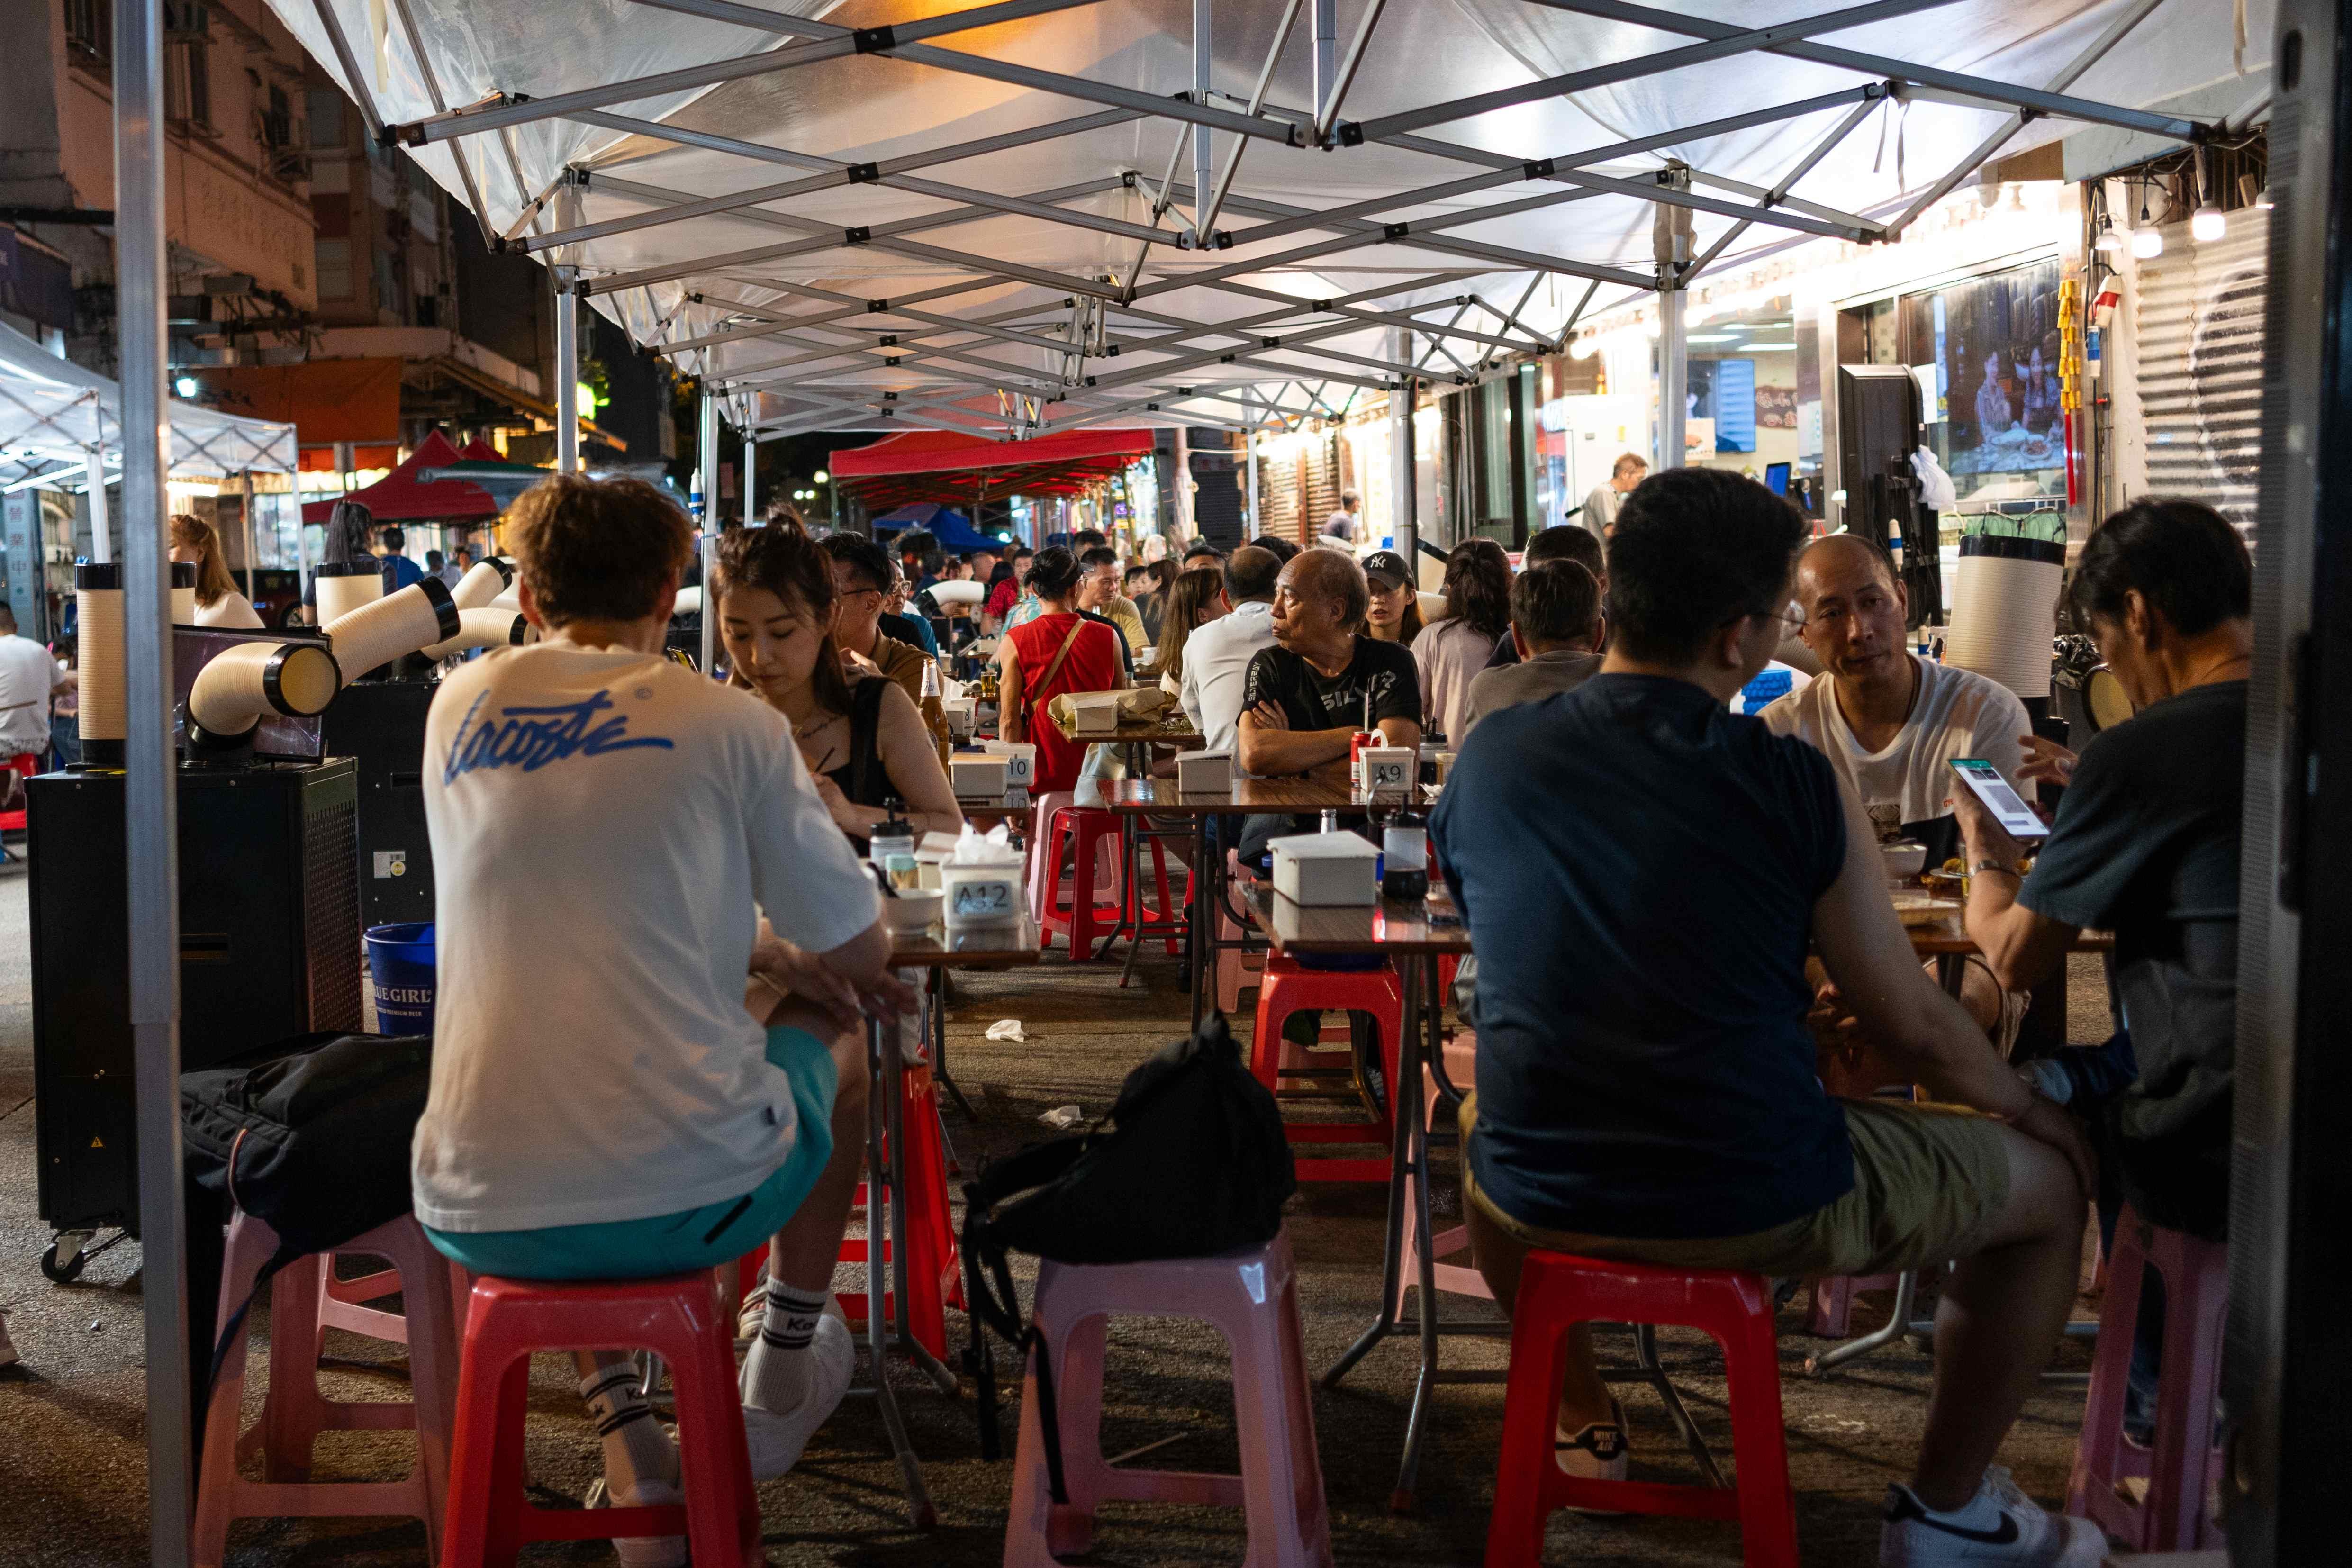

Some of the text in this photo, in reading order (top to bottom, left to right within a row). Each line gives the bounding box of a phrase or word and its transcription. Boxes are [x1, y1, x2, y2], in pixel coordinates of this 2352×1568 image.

[1376, 765, 1401, 782] A9
[954, 884, 1008, 910] A12
[375, 986, 431, 1003] LUE GIRL
